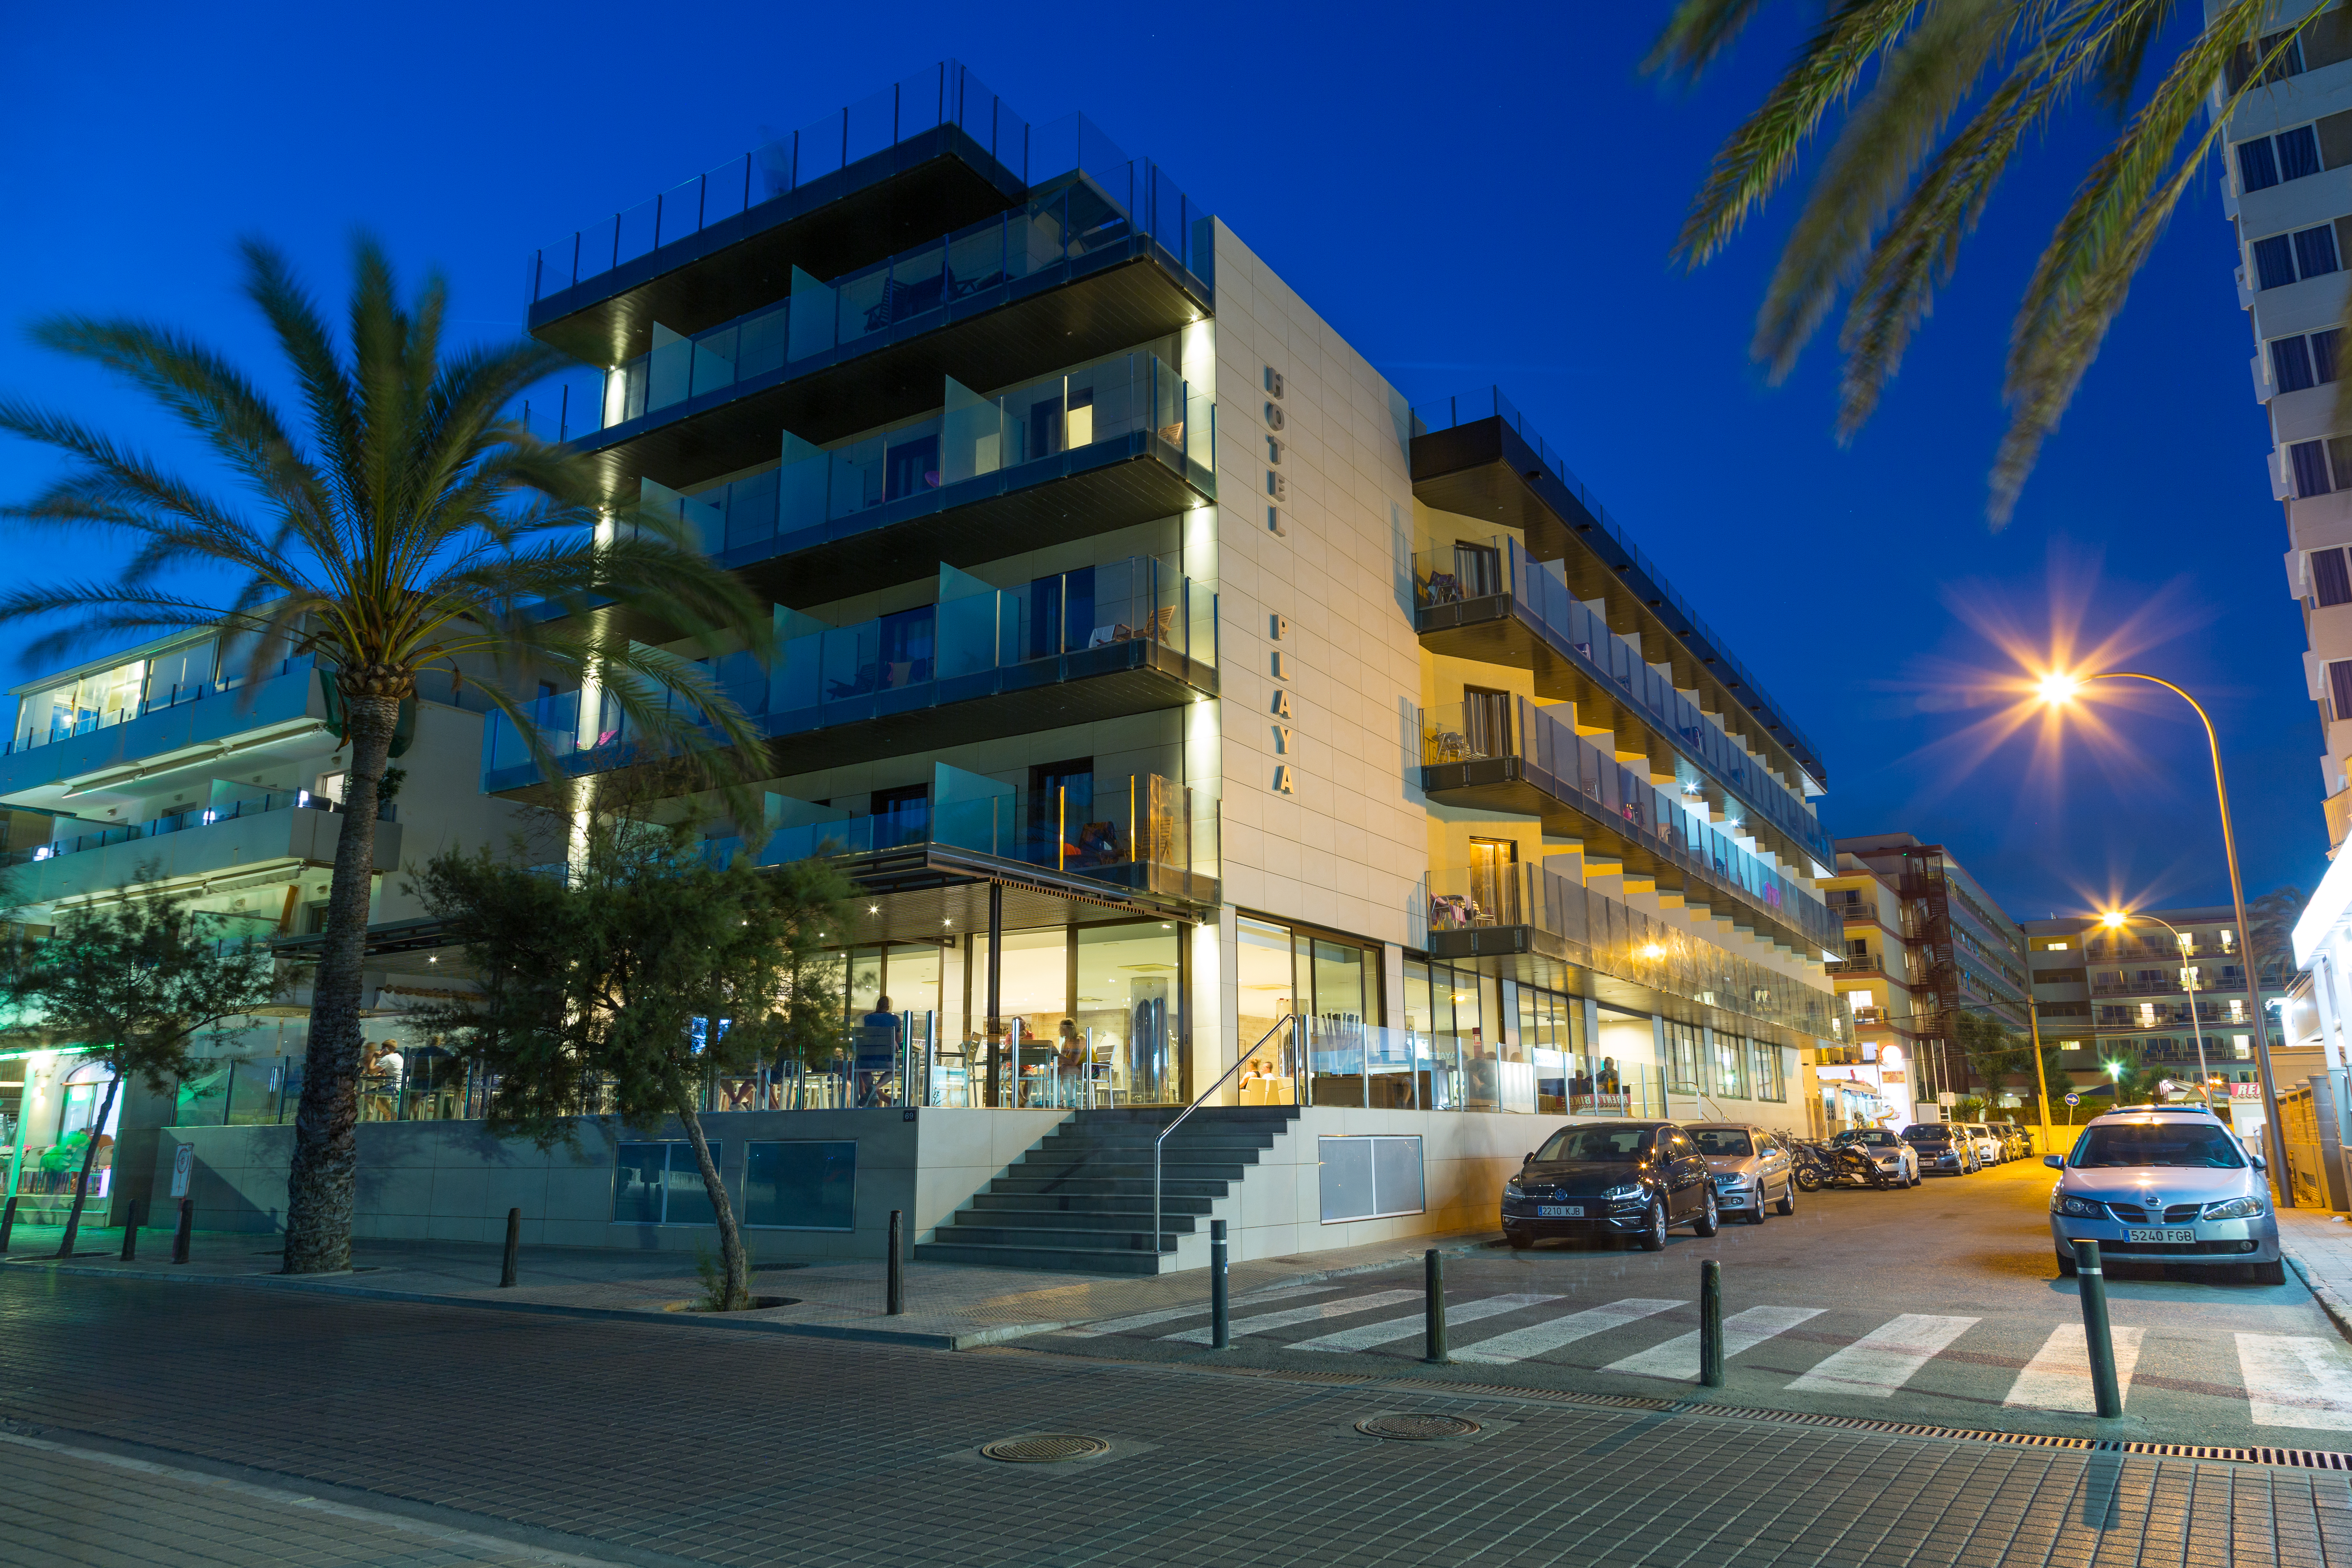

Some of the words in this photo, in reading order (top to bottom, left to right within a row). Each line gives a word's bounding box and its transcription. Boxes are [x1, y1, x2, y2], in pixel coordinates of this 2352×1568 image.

[1264, 364, 1286, 538] HOTEL
[1270, 613, 1294, 795] PLAYA
[1429, 1051, 1455, 1060] PAYA
[1543, 1207, 1561, 1215] 2210
[1566, 1207, 1580, 1215] KJB
[2131, 1231, 2164, 1241] 5240
[2167, 1231, 2192, 1241] FGB
